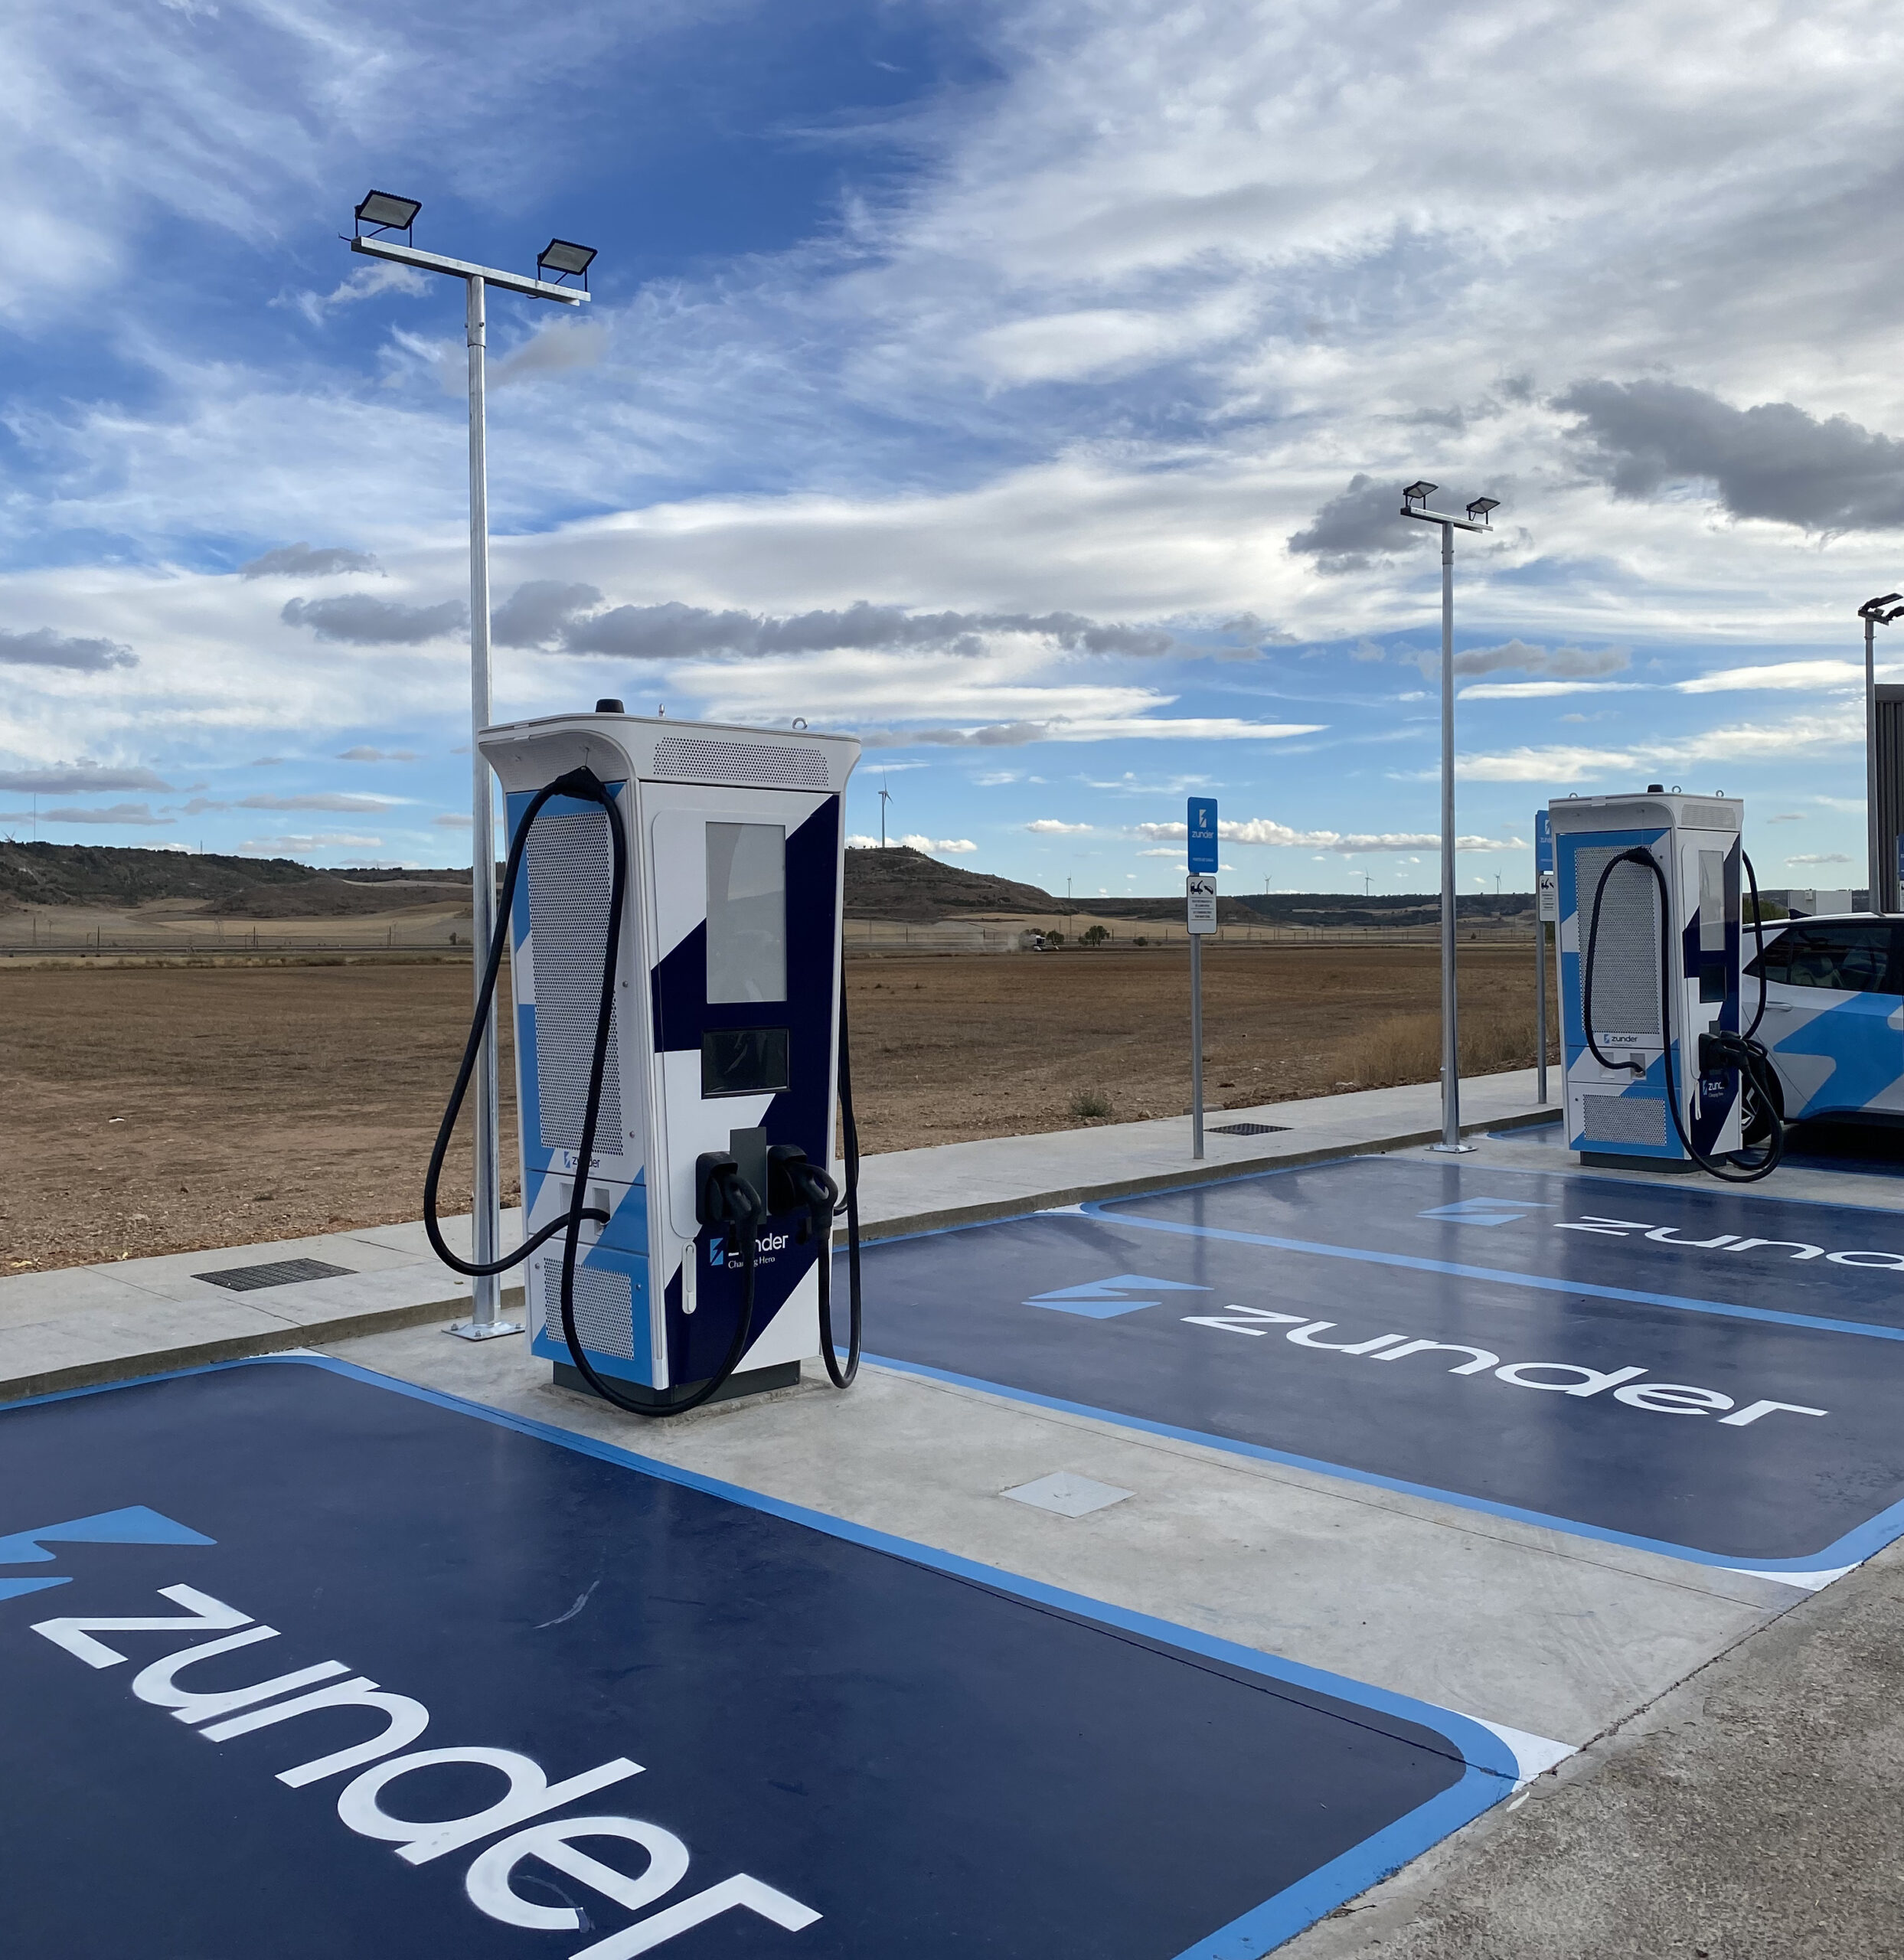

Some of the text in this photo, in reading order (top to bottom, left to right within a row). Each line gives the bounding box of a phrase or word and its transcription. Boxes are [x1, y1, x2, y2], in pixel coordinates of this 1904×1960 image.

[1191, 830, 1214, 839] zunder
[728, 1233, 789, 1256] nder
[759, 1256, 776, 1265] Hero
[1180, 1304, 1829, 1426] zunder
[29, 1583, 823, 1960] zunder
